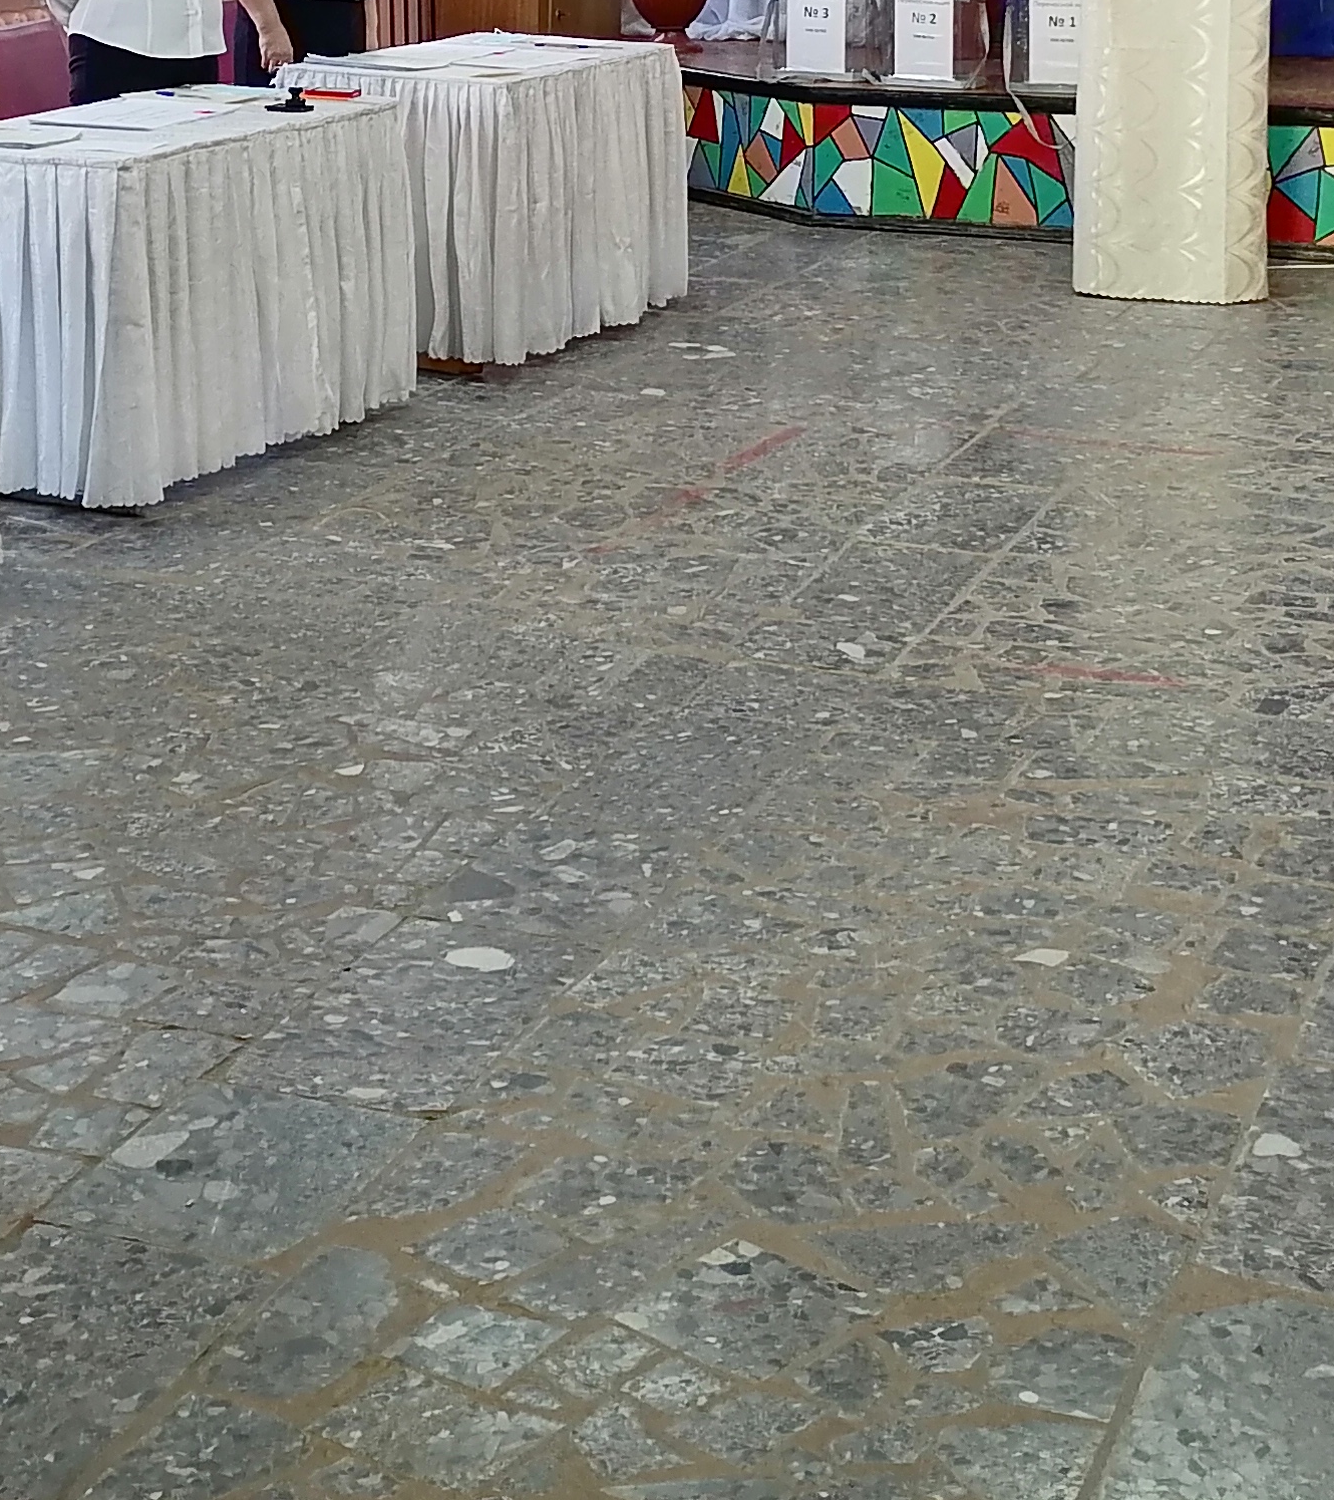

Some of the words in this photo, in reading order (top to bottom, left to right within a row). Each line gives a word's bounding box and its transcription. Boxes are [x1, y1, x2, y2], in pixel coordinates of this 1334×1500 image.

[822, 8, 830, 19] 3
[929, 13, 937, 25] 2
[1069, 16, 1076, 27] 1
